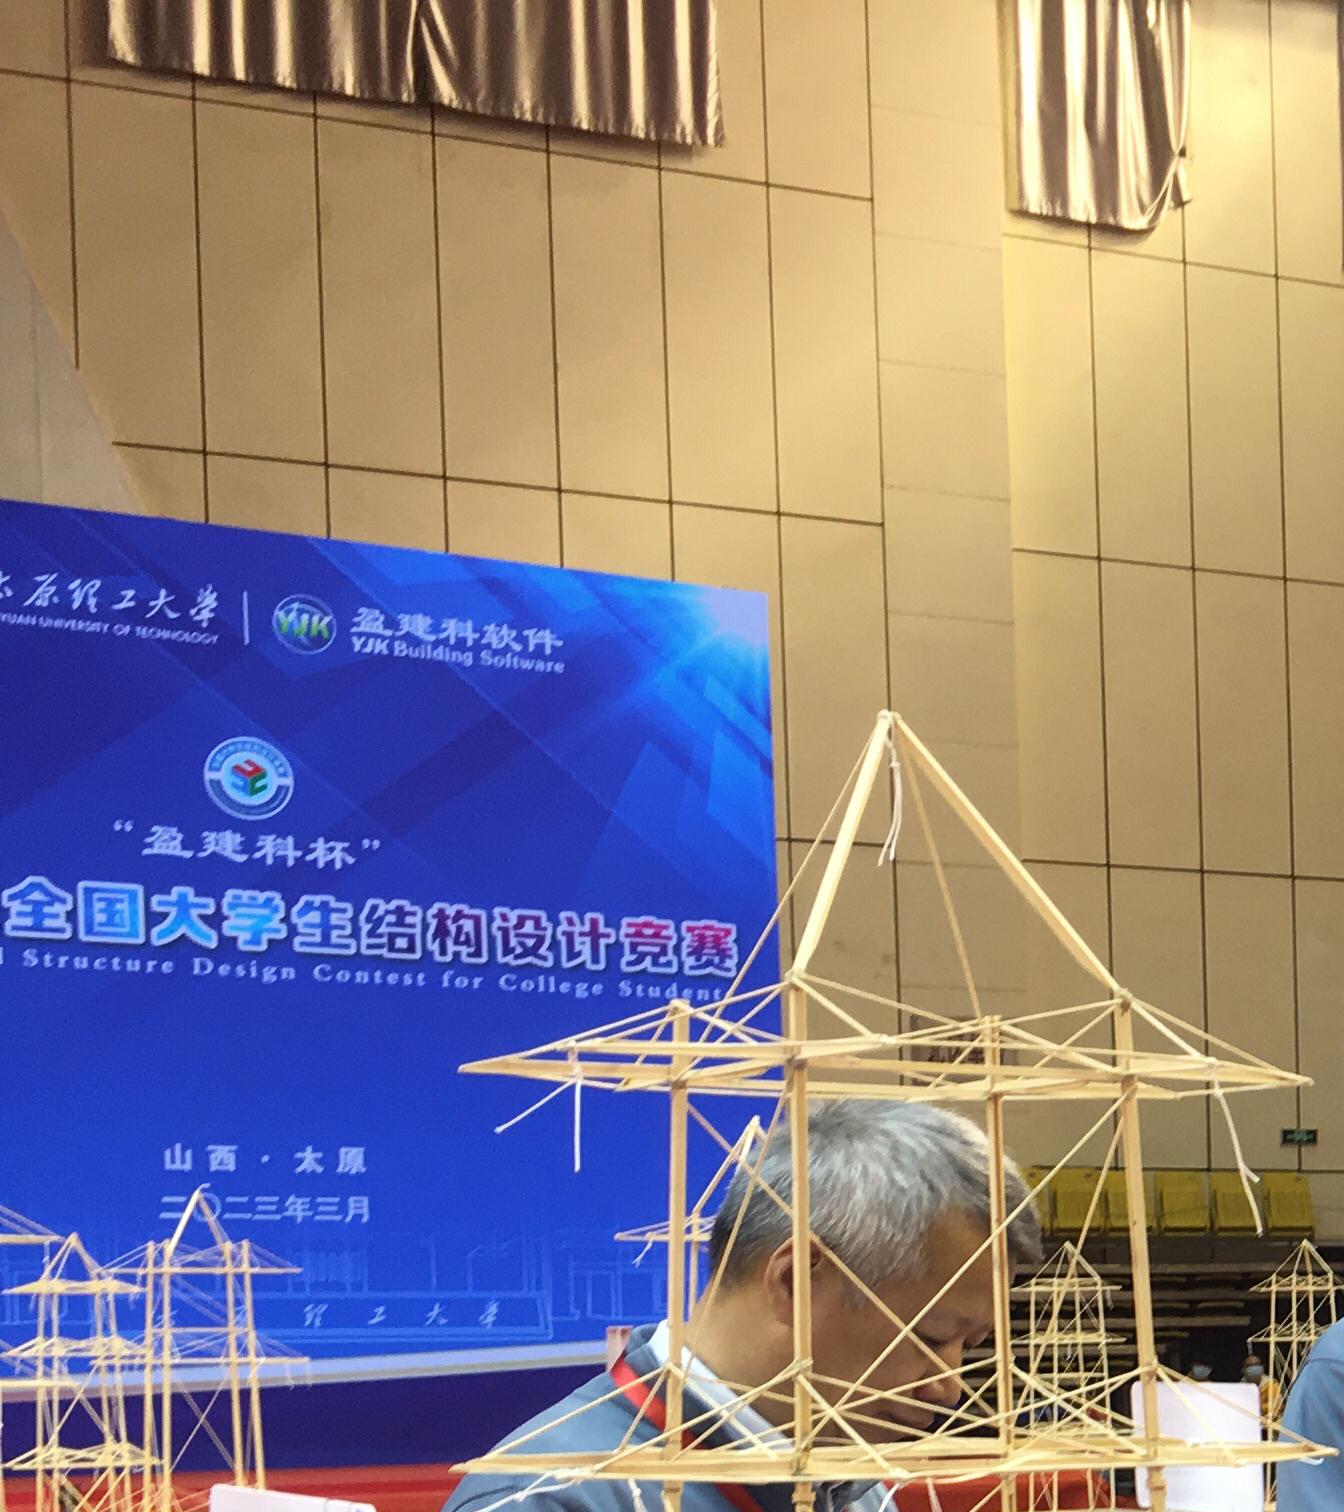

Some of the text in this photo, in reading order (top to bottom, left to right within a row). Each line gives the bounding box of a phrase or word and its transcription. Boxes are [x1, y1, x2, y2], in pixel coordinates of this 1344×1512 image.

[113, 622, 130, 637] OF
[135, 626, 219, 645] TECHNOLOGY
[276, 602, 332, 641] YJK
[351, 606, 563, 655] 盈建科软件
[351, 636, 565, 674] YJK Building Software
[1, 875, 737, 978] 全国大学生结构设计竞赛
[22, 947, 174, 974] Structure
[192, 956, 296, 984] Design
[312, 963, 426, 987] Contest
[440, 969, 484, 990] for
[498, 972, 604, 999] College
[618, 979, 722, 1001] Student
